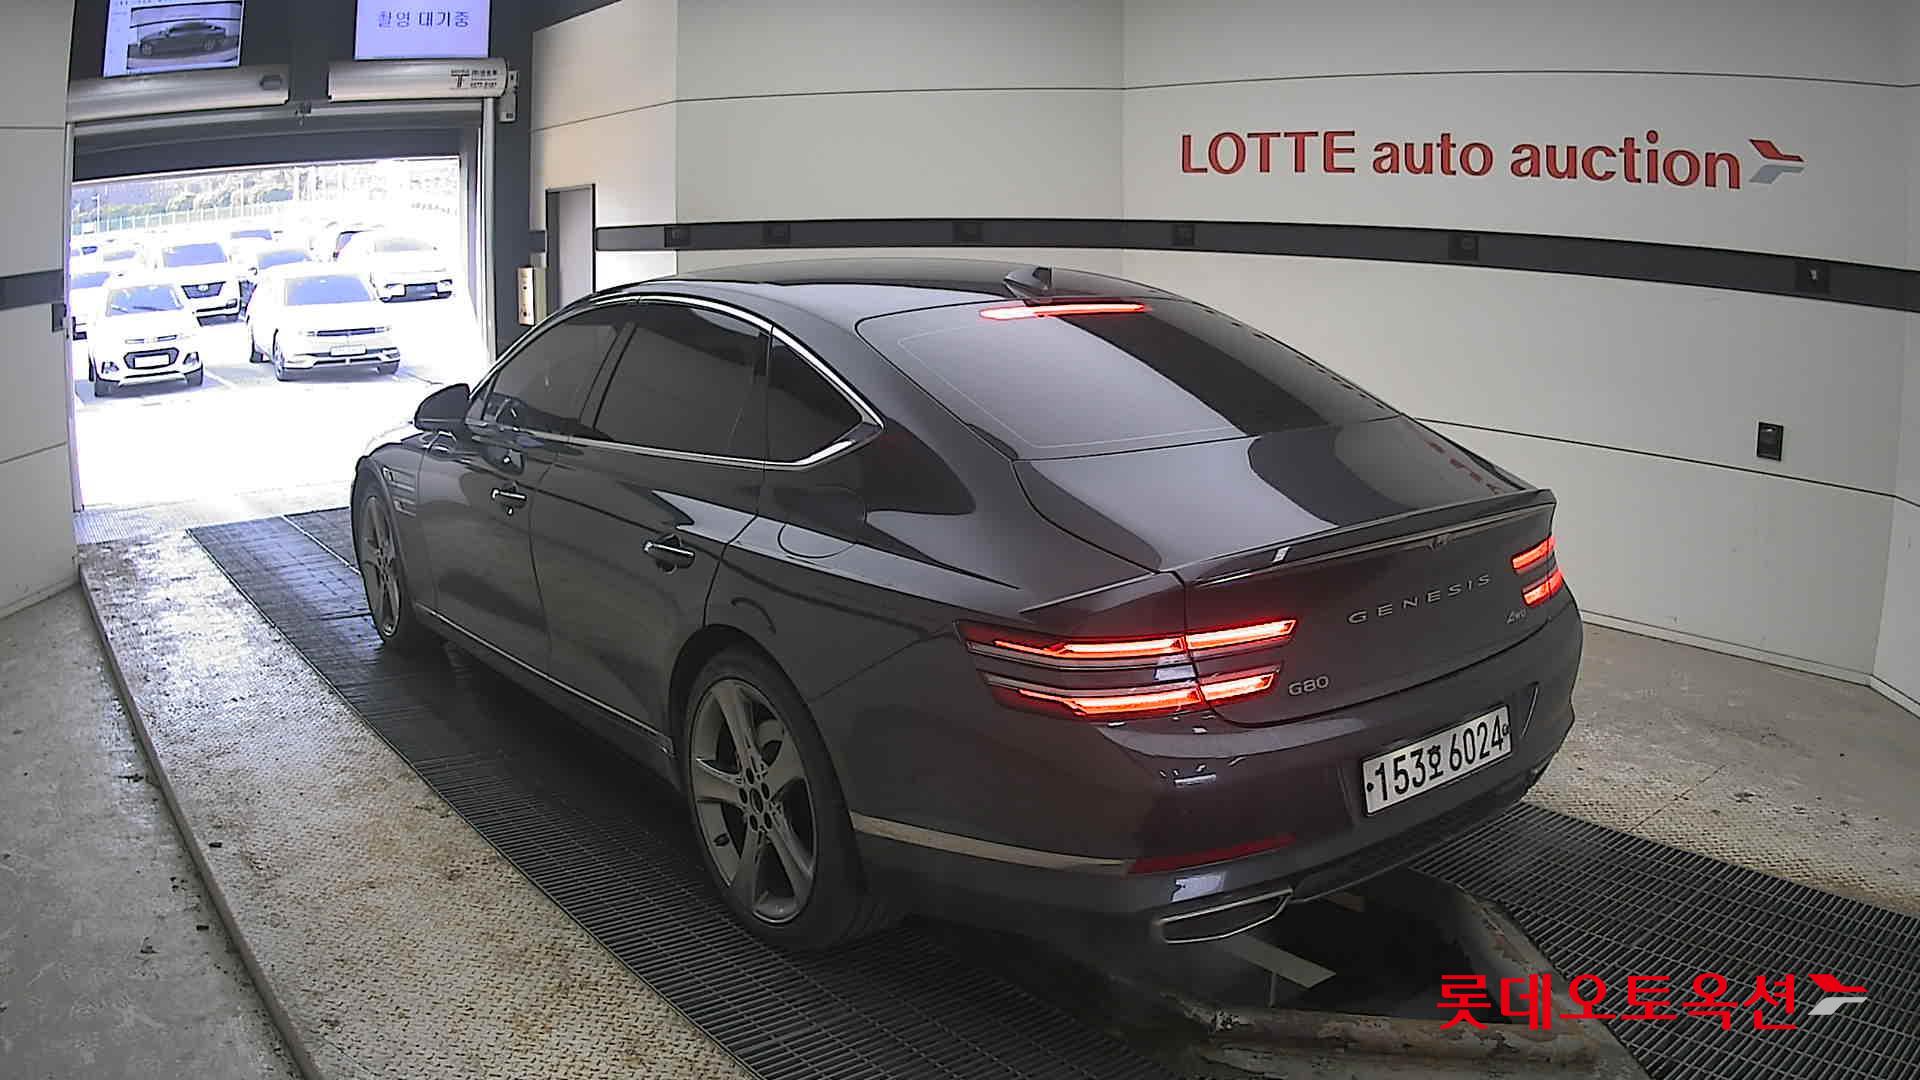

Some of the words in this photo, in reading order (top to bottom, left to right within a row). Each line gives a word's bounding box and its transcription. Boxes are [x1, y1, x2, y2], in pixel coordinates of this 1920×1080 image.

[418, 11, 469, 28] 대기중
[1181, 131, 1355, 174] LOTTE
[1373, 133, 1494, 176] auto
[1511, 129, 1742, 190] auction
[1348, 575, 1490, 624] GENESIS
[1288, 675, 1329, 696] G80
[1375, 746, 1444, 801] 153호
[1449, 715, 1504, 772] 6024
